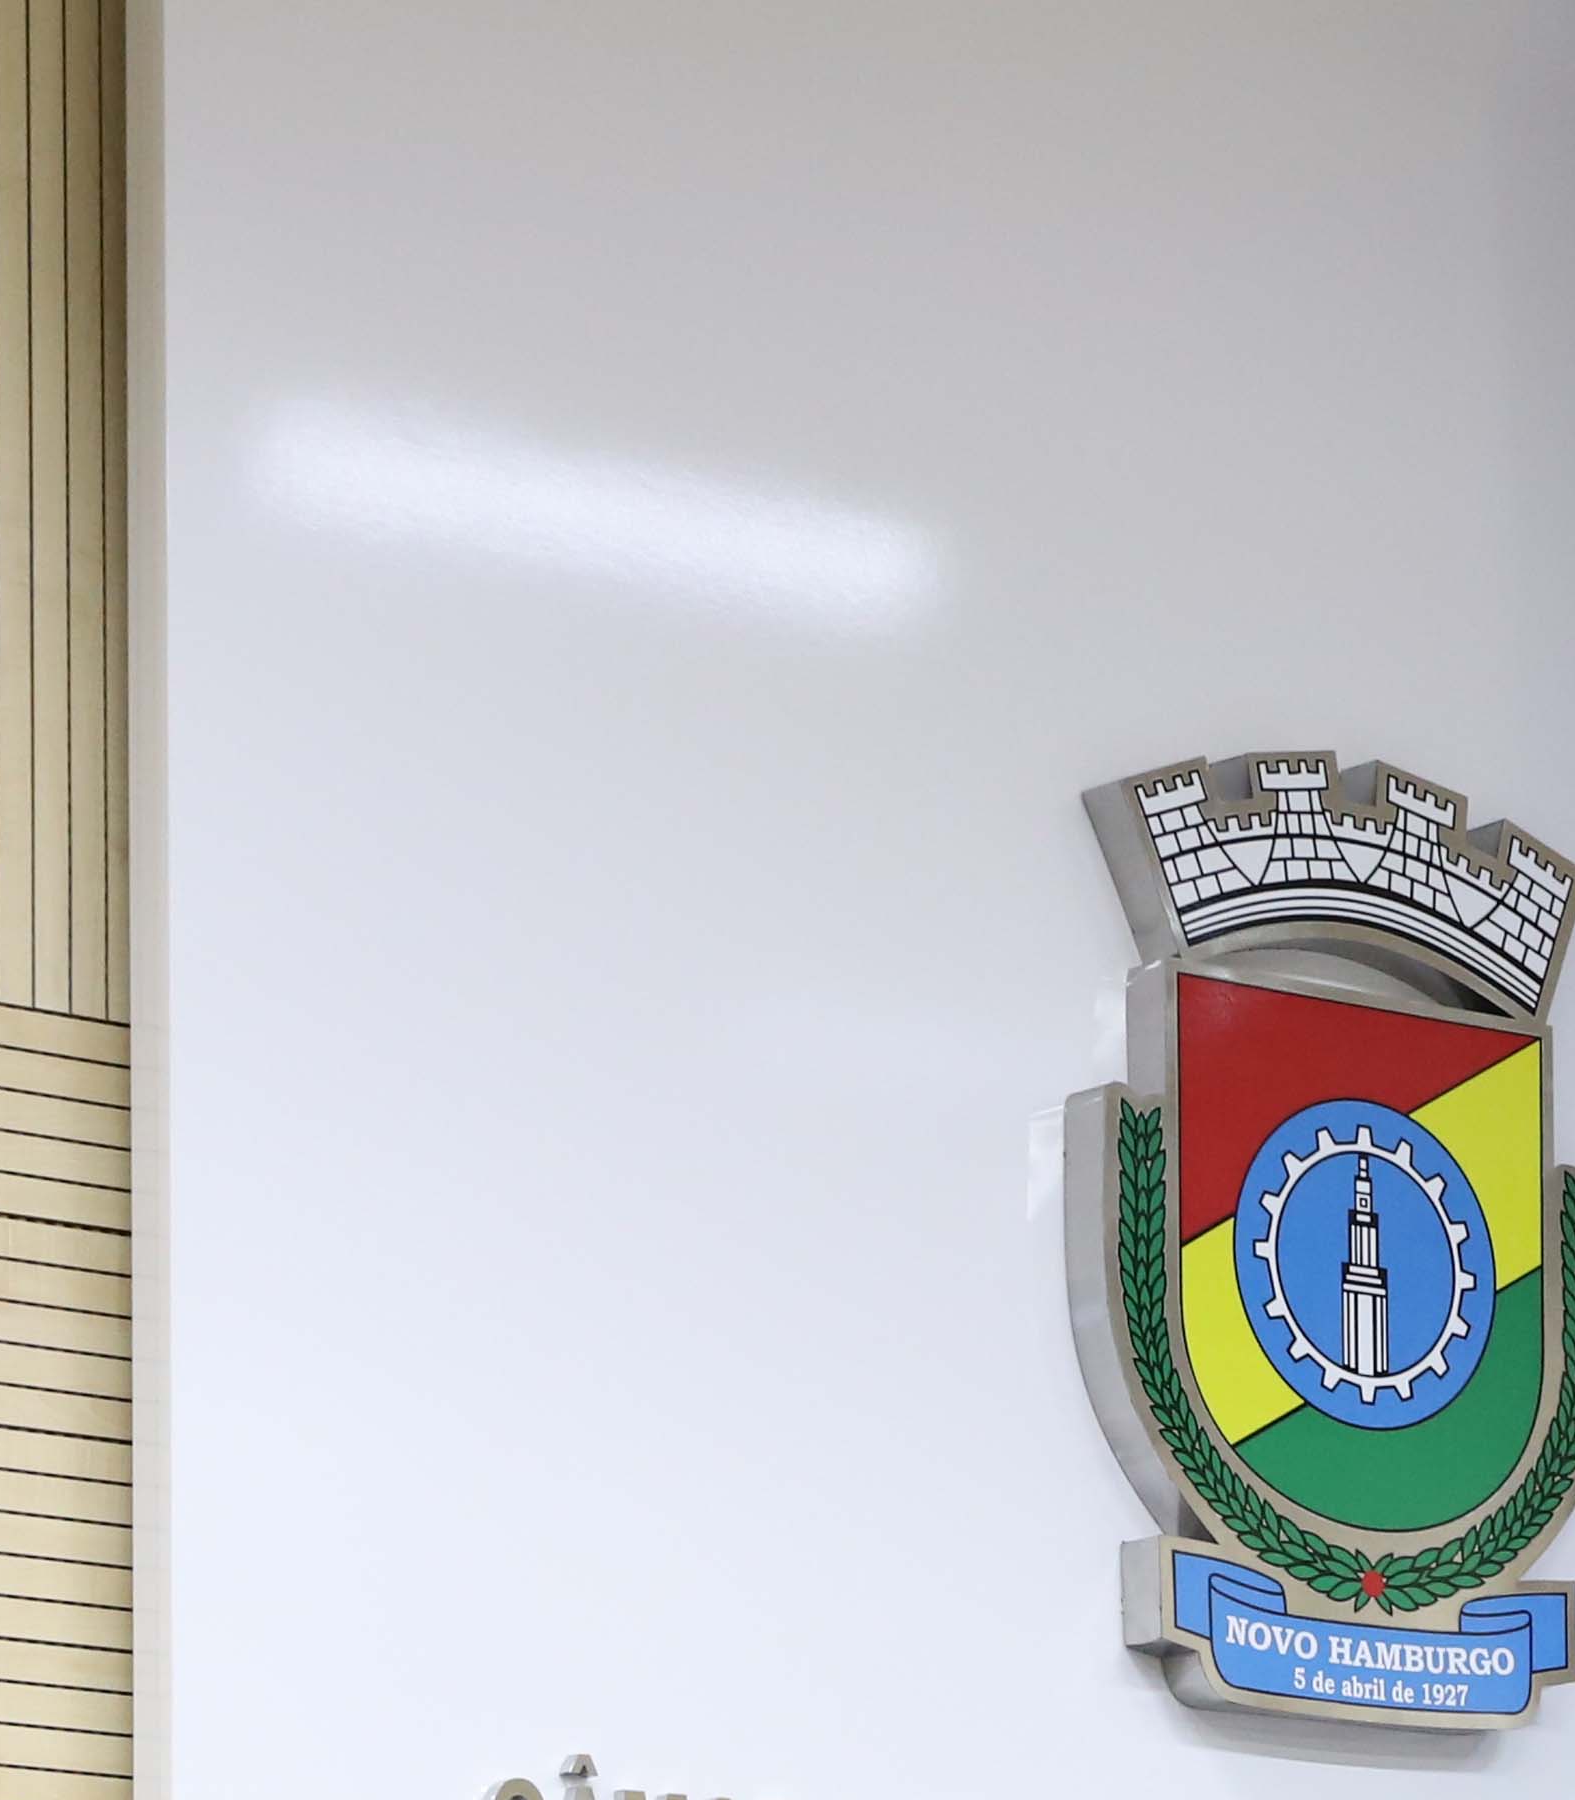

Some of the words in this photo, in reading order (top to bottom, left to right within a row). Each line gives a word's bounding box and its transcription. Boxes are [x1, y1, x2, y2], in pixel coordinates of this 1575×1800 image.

[1225, 1614, 1319, 1661] NOVO
[1328, 1635, 1516, 1677] HAMBURGO
[1293, 1665, 1306, 1690] 5
[1311, 1671, 1336, 1695] de
[1340, 1675, 1387, 1702] abril
[1391, 1680, 1415, 1704] de
[1421, 1682, 1470, 1708] 1927
